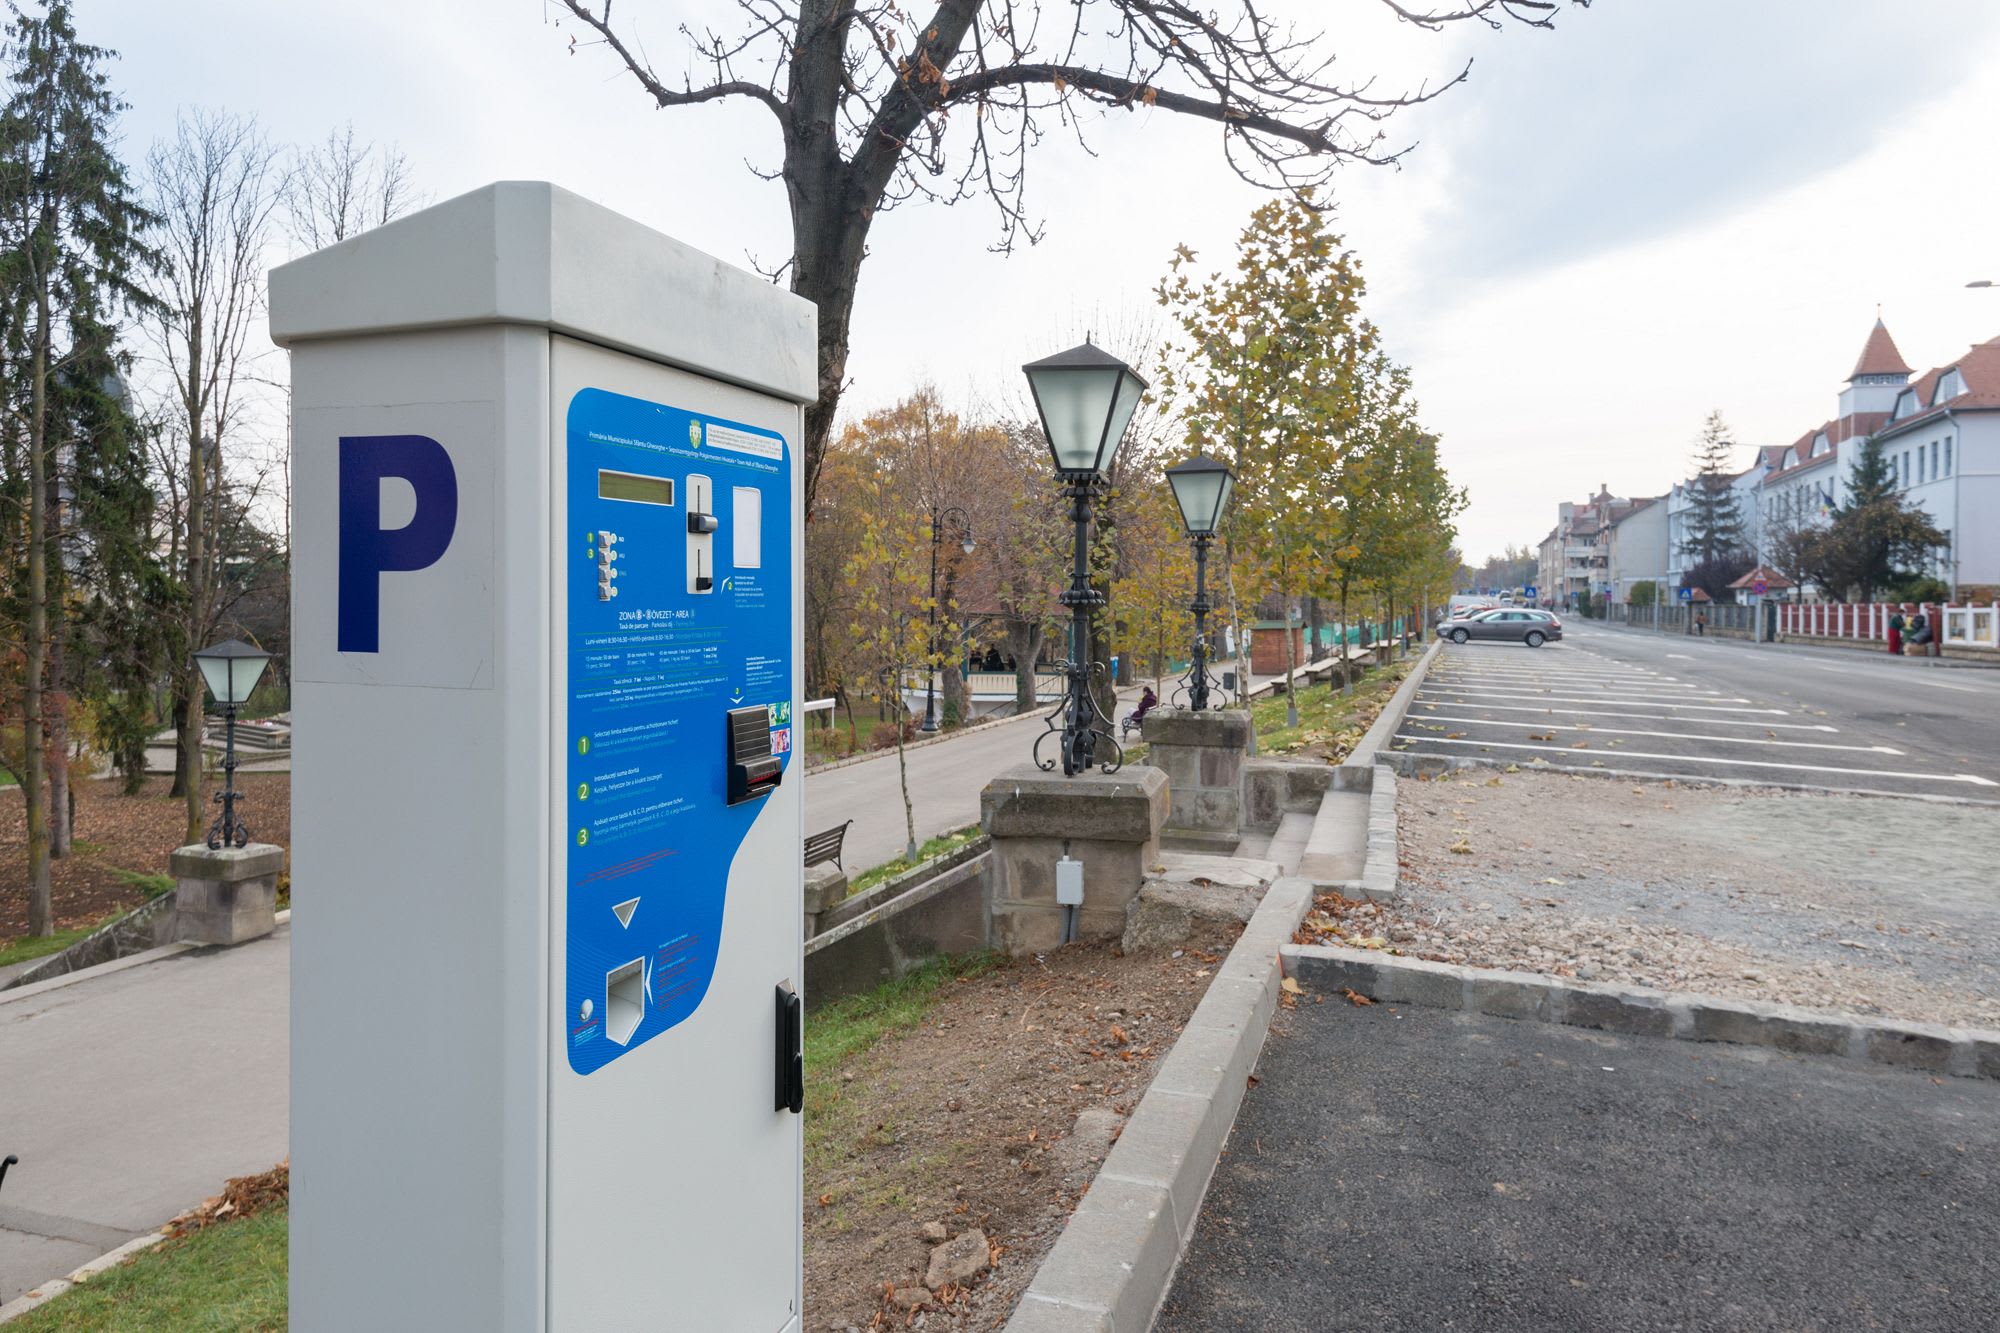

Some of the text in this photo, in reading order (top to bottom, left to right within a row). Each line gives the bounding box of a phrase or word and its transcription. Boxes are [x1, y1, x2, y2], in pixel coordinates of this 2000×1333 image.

[338, 434, 458, 653] P
[618, 611, 636, 621] ZONA
[675, 610, 689, 619] AREA
[580, 783, 587, 800] 2
[580, 829, 587, 845] 3
